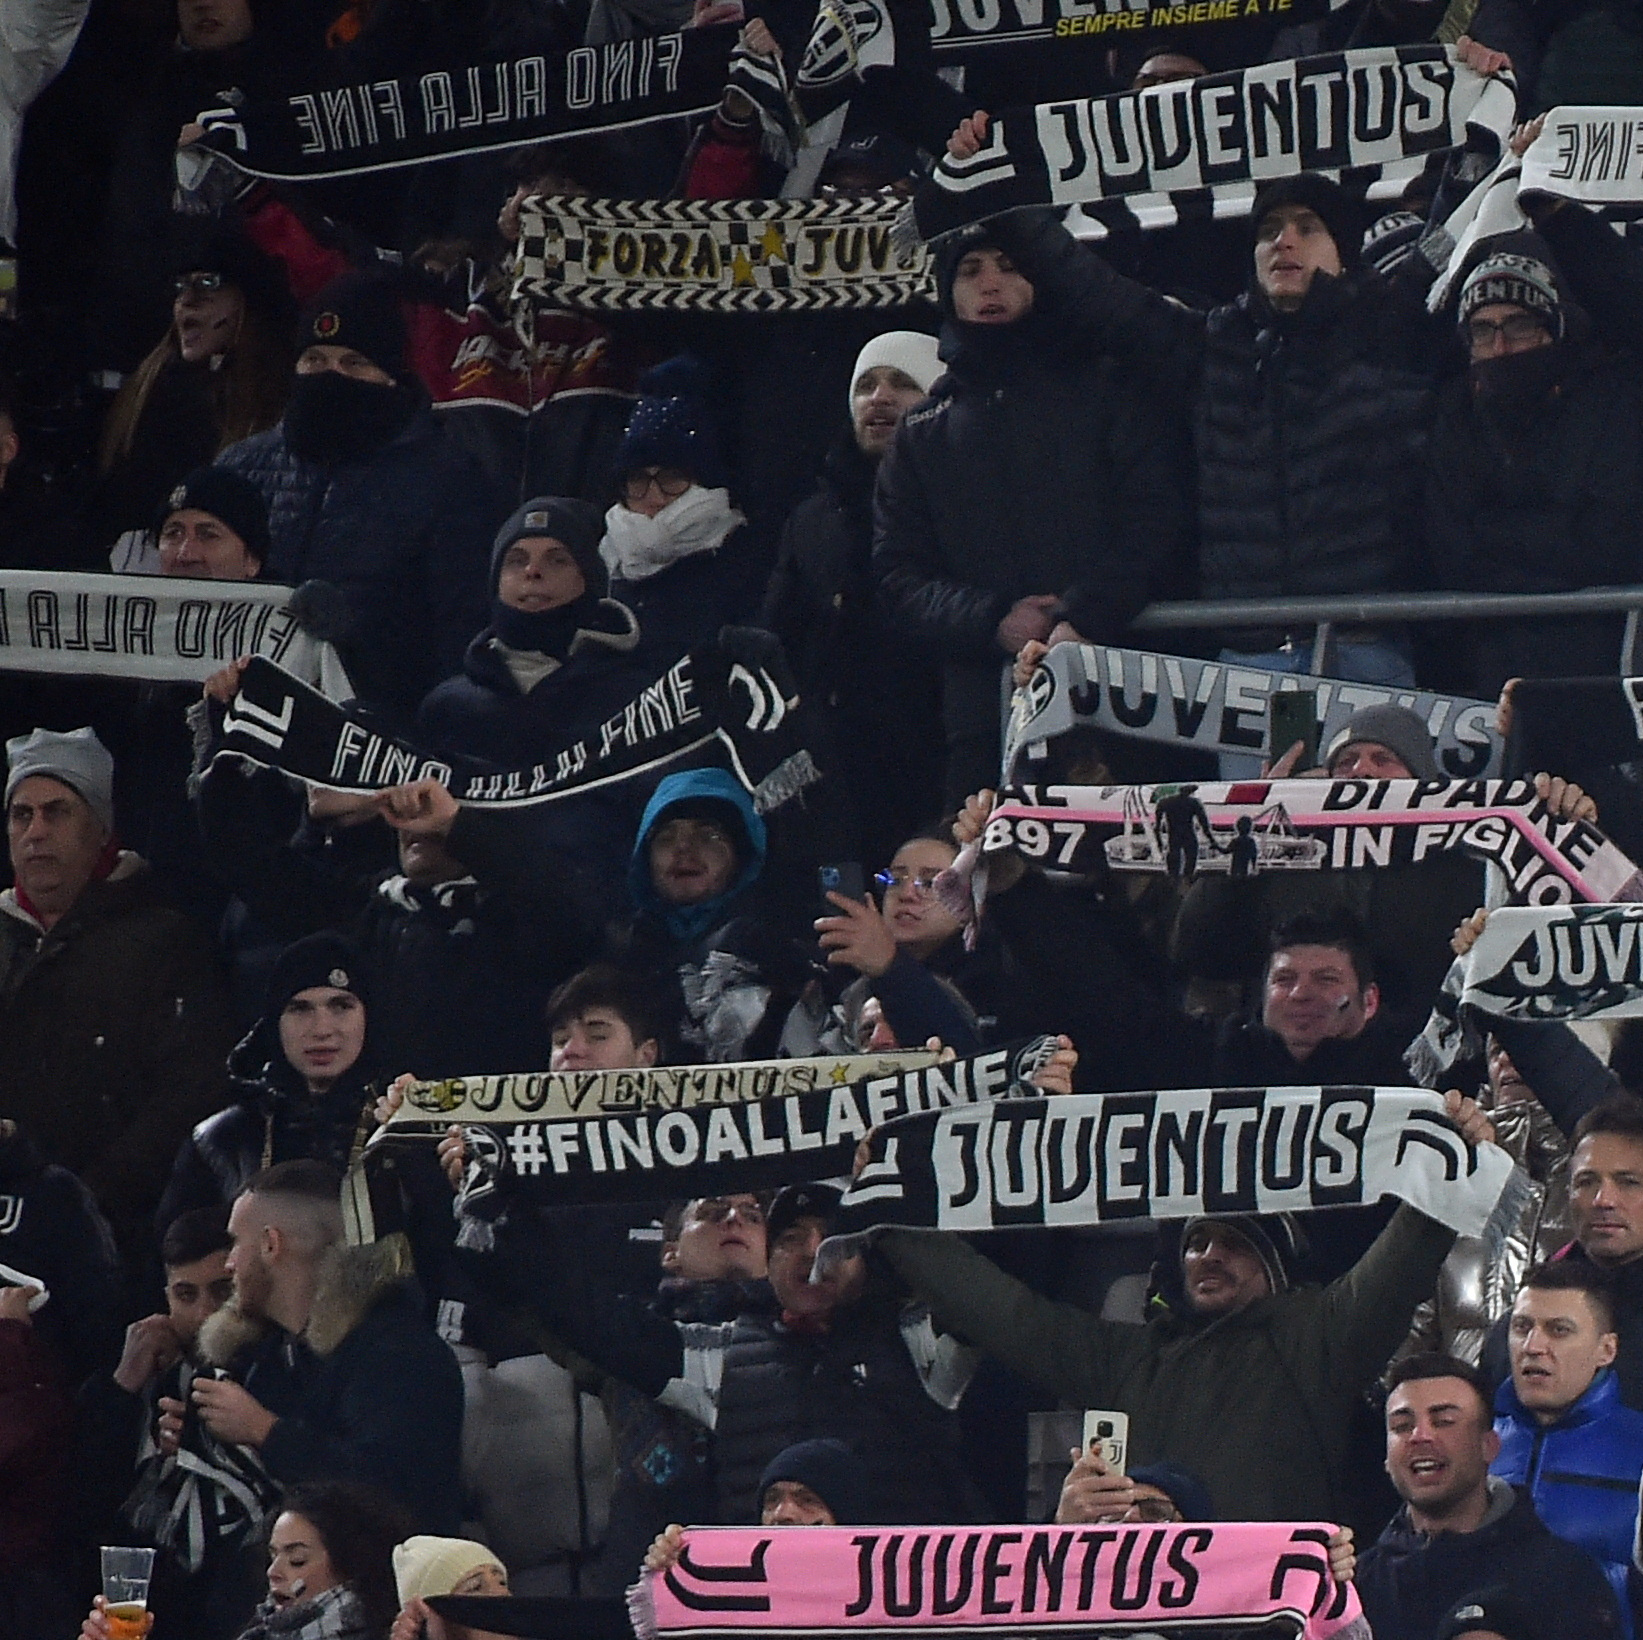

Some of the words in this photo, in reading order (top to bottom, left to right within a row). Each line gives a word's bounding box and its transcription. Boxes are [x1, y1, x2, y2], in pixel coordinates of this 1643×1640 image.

[1055, 11, 1147, 39] SEMPRE
[1150, 1, 1233, 28] INSIEME
[1049, 56, 1451, 183] JUVENTUS
[582, 222, 718, 278] FORZA
[802, 223, 916, 276] JUV
[330, 719, 454, 789] FINO
[598, 653, 702, 759] FINE
[1323, 780, 1396, 812] DI
[983, 818, 1086, 864] 897
[1331, 823, 1393, 869] IN
[1410, 819, 1577, 910] FIGLIO
[469, 1064, 822, 1112] JUVENTUS
[506, 1048, 1010, 1178] #FINOALLAFINE
[940, 1091, 1366, 1208] JUVENTUS
[845, 1526, 1213, 1619] JUVENTUS
